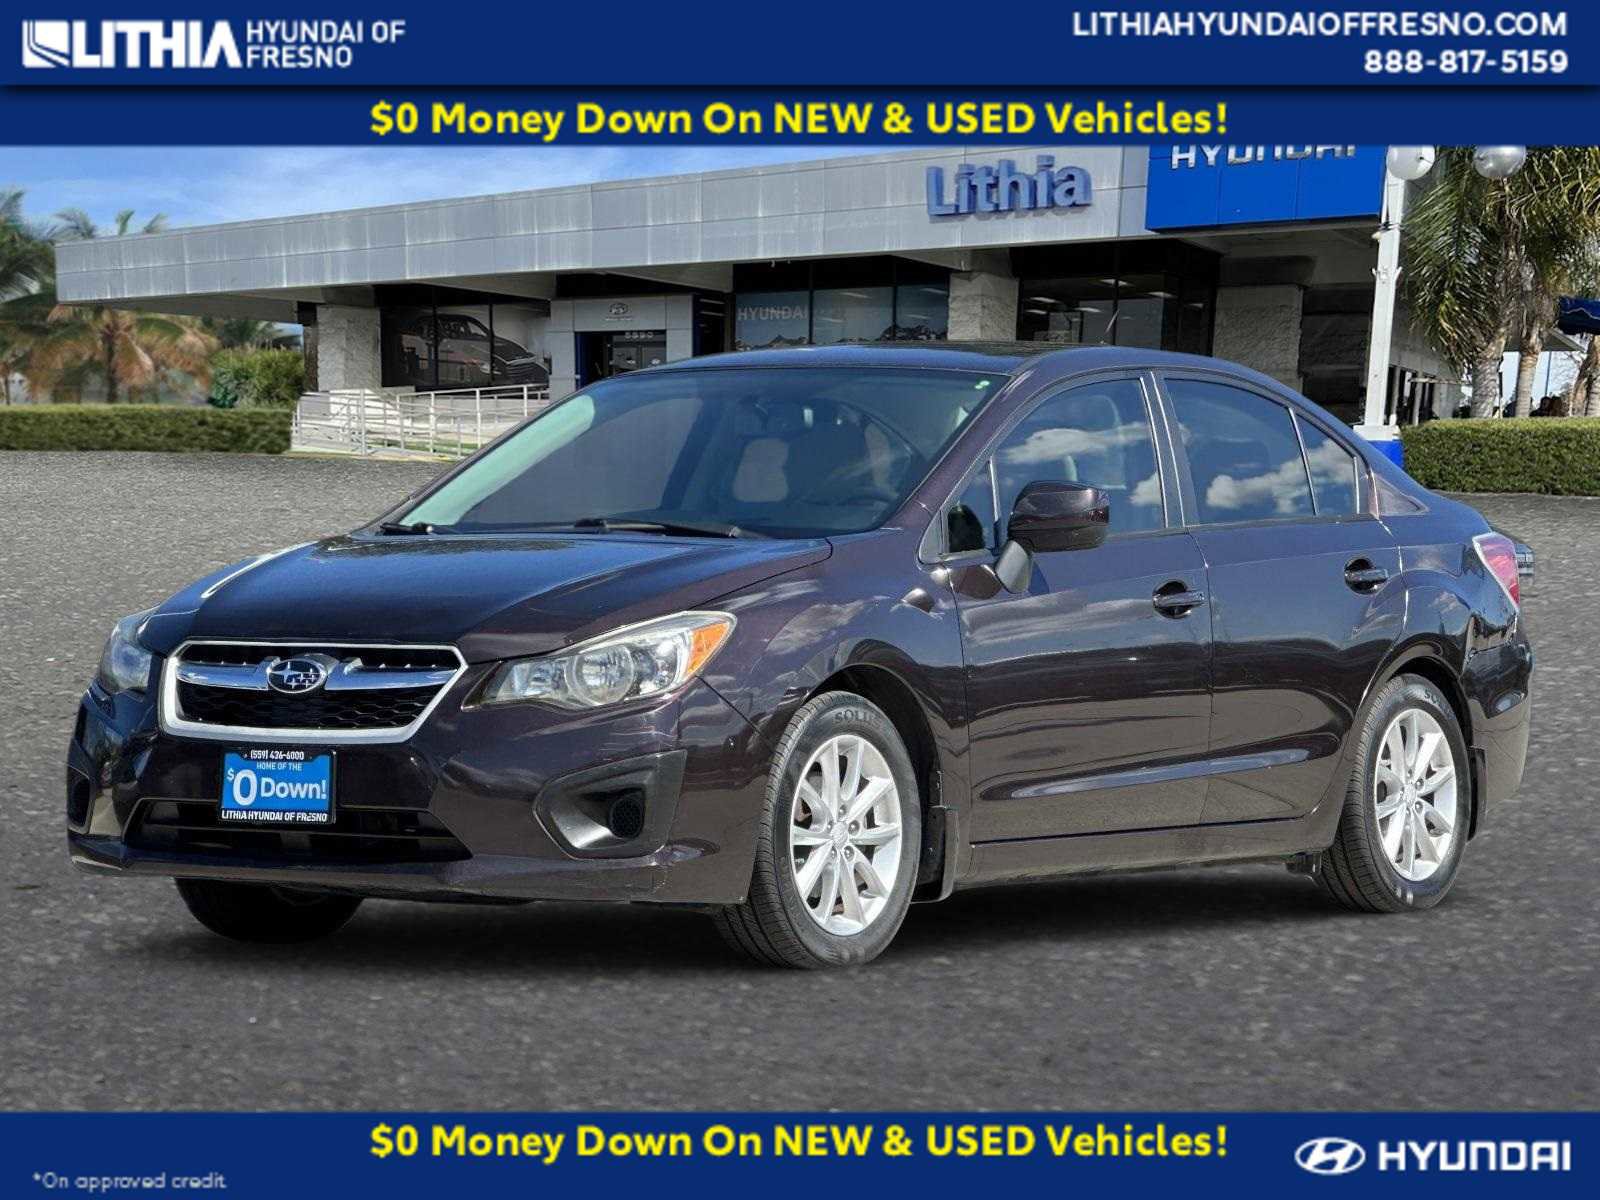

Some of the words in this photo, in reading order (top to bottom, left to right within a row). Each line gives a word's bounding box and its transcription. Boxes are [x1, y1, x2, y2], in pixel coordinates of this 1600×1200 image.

[927, 155, 1092, 215] Lithia
[737, 305, 808, 321] HYUNDAI
[256, 761, 276, 770] HOME
[277, 762, 287, 770] OF
[288, 763, 302, 771] THE
[260, 777, 327, 799] Down!
[221, 810, 248, 819] LITHIA
[248, 810, 282, 820] HYUNDAI
[284, 812, 295, 821] OF
[296, 812, 328, 822] FRESNO
